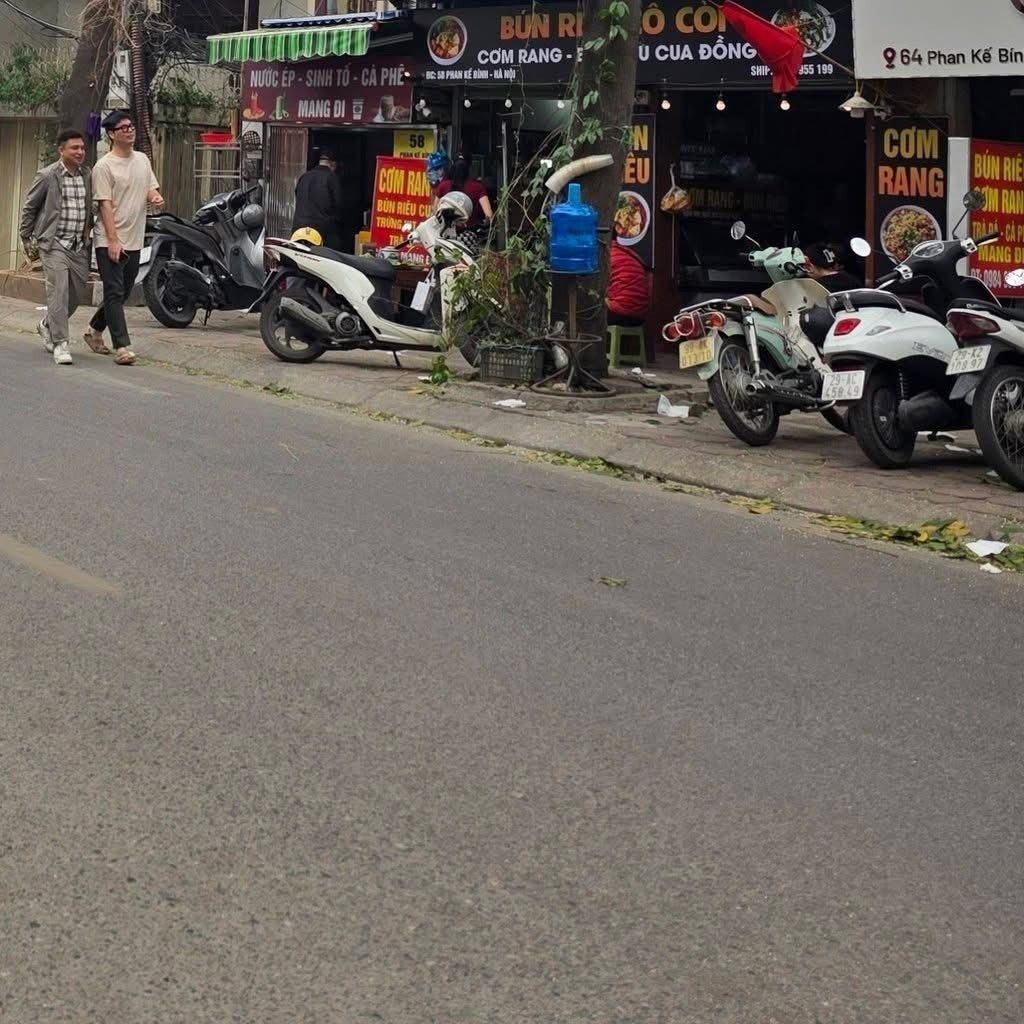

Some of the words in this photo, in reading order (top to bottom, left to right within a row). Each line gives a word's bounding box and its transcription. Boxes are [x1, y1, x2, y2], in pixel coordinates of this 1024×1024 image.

[500, 10, 550, 40] BÚN
[558, 12, 584, 38] RI
[478, 47, 514, 64] CƠM
[518, 48, 563, 64] RANG
[655, 45, 693, 61] CUA
[699, 35, 757, 60] ĐỒNG
[900, 48, 922, 65] 64
[928, 51, 965, 64] Phan
[972, 46, 992, 64] Kế
[251, 67, 279, 88] NƯỚC
[282, 66, 295, 88] ÉP
[306, 68, 333, 88] SINH
[336, 62, 352, 87] TỐ
[381, 64, 405, 86] PHÊ
[446, 70, 463, 80] PHAN
[464, 67, 472, 79] KẾ
[494, 68, 503, 79] HÀ
[816, 64, 834, 75] 199
[298, 100, 331, 118] MANG
[409, 135, 425, 148] 58
[883, 126, 938, 159] CƠM
[624, 151, 649, 183] ÊU
[974, 148, 1000, 180] BÚN
[1003, 153, 1024, 182] RIÊ
[379, 166, 404, 195] CƠM
[407, 170, 431, 197] RAN
[878, 166, 944, 198] RANG
[377, 197, 395, 214] BÚN
[397, 200, 416, 216] RIÊU
[419, 204, 431, 219] CU
[974, 185, 998, 212] ƠM
[978, 245, 1011, 263] MANG
